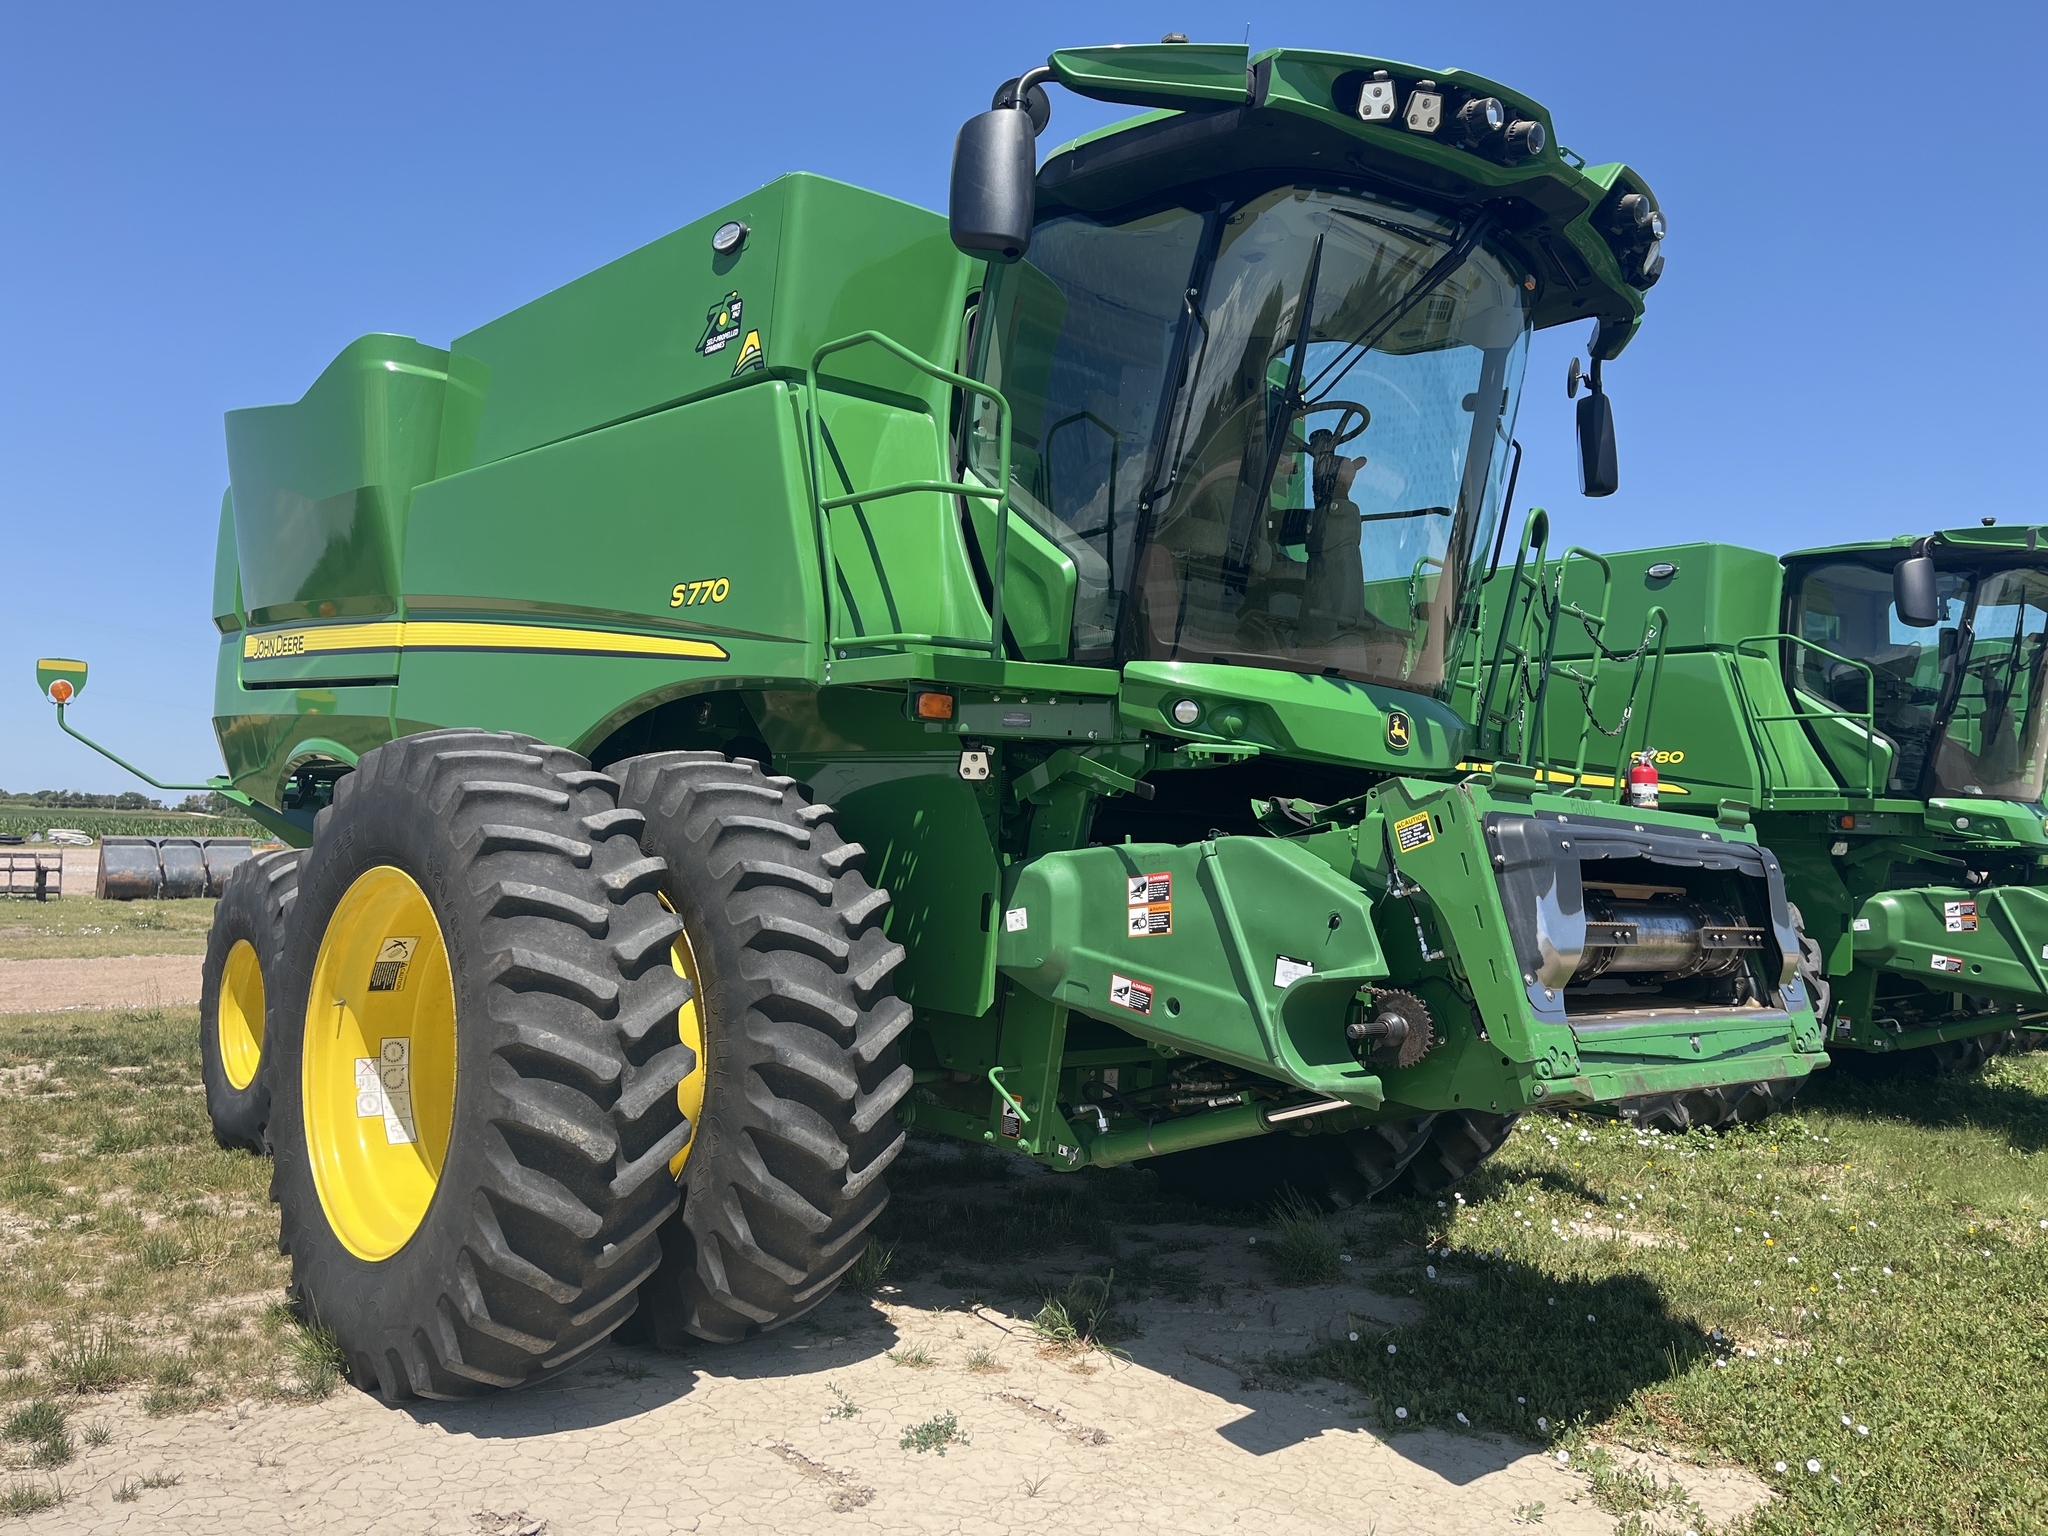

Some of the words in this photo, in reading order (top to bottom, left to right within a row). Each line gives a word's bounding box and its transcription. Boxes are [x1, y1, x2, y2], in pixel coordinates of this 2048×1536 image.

[670, 576, 731, 608] S770
[253, 637, 276, 657] JOHN
[276, 634, 304, 654] DEERE
[1400, 813, 1427, 828] CAUTION
[396, 967, 406, 990] CAUTION
